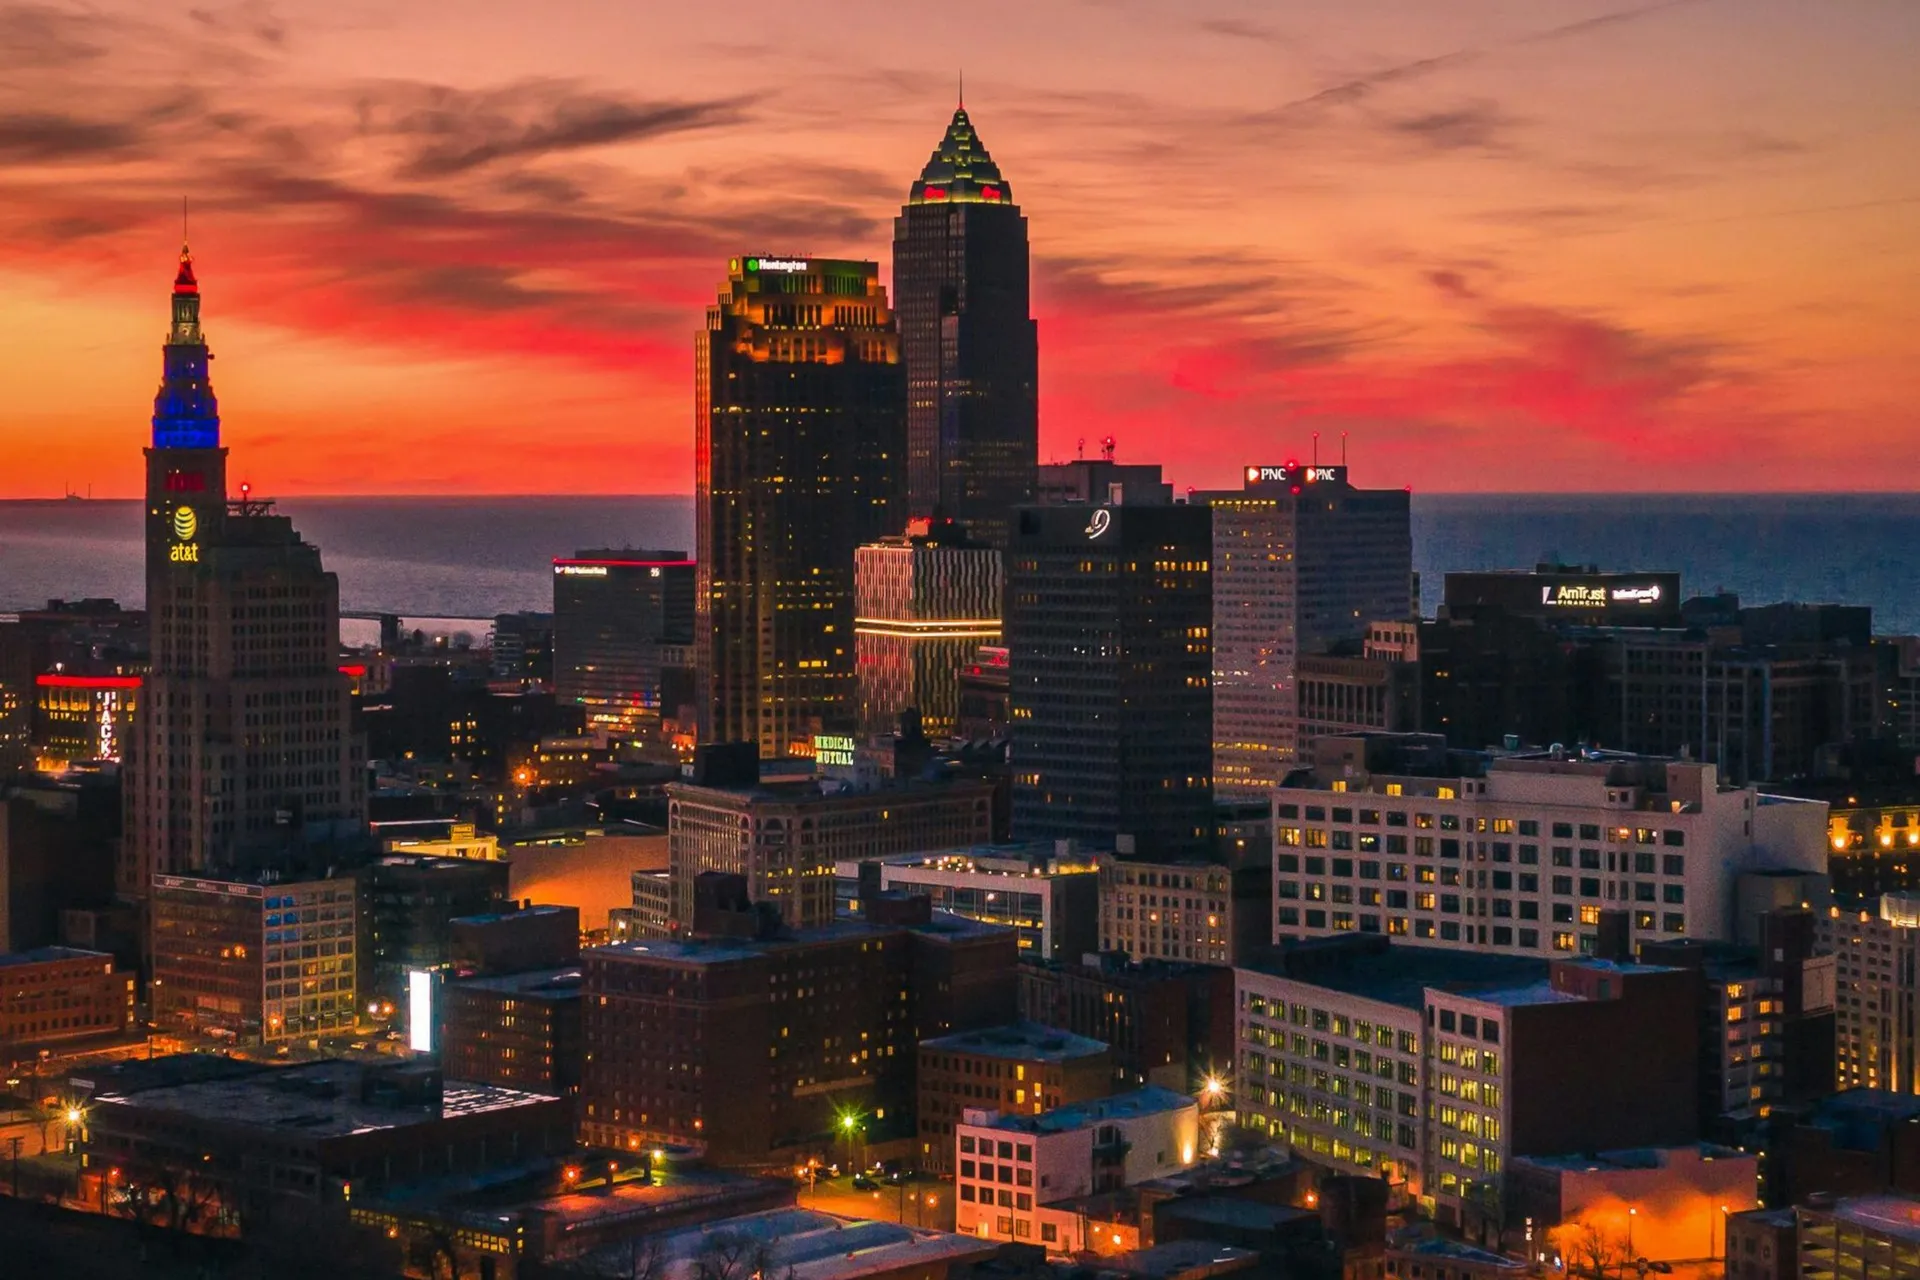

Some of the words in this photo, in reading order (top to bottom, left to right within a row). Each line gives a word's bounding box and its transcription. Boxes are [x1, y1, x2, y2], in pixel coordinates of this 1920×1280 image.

[1261, 468, 1287, 481] PNC
[1316, 468, 1336, 481] PNC
[170, 542, 199, 562] at&t
[1557, 586, 1606, 600] AmTrust
[101, 692, 112, 754] JACK
[814, 735, 855, 750] MEDICAL
[816, 750, 854, 765] MUTUAL
